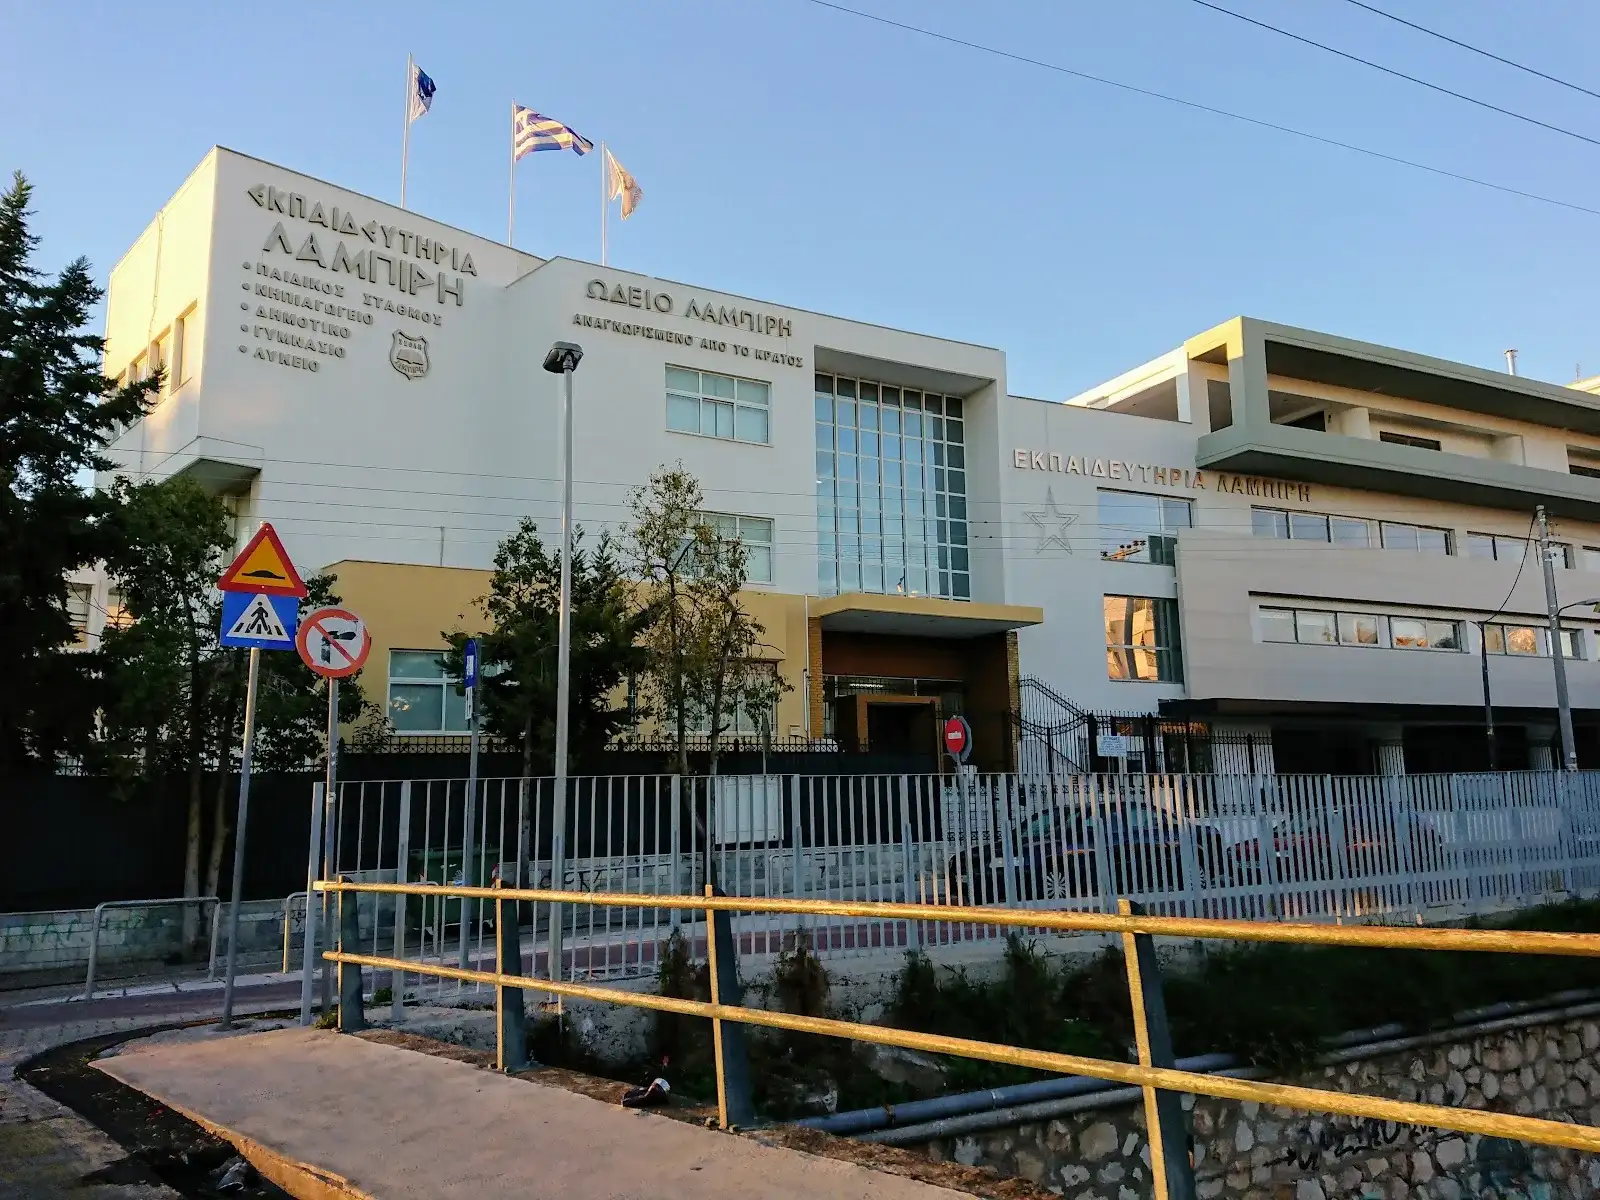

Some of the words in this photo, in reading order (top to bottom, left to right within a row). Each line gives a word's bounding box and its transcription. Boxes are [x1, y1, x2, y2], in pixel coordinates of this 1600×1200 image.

[248, 183, 478, 277] ΕΚΠΑΙΔΕΥΤΗΡΙΑ
[263, 221, 463, 306] ΛΑΜΠΙΡΗ
[255, 283, 374, 325] ΝΗΠΙΑΓΩΓΕΙΟ
[256, 262, 345, 297] ΠΑΙΔΙΚΟΣ
[363, 293, 442, 326] ΣΤΑΘΜΟΣ
[586, 278, 673, 313] ΩΔΕΙΟ
[686, 299, 792, 337] ΛΑΜΠΙΡΗ
[254, 325, 346, 358] ΓΥΜΝΑΣΙΟ
[256, 305, 351, 338] ΔΗΜΟΤΙΚΟ
[572, 313, 694, 346] ΑΝΑΓΝΩΡΙΣΜΕΝΟ
[700, 337, 727, 353] ΑΠΟ
[733, 343, 749, 357] ΤΟ
[755, 349, 803, 368] ΚΡΑΤΟΣ
[254, 347, 319, 372] ΛΥΚΕΙΟ
[1014, 448, 1206, 490] ΕΚΠΑΙΔΕΥΤΗΡΙΑ
[1217, 474, 1311, 502] ΛΑΜΠΙΡΗ
